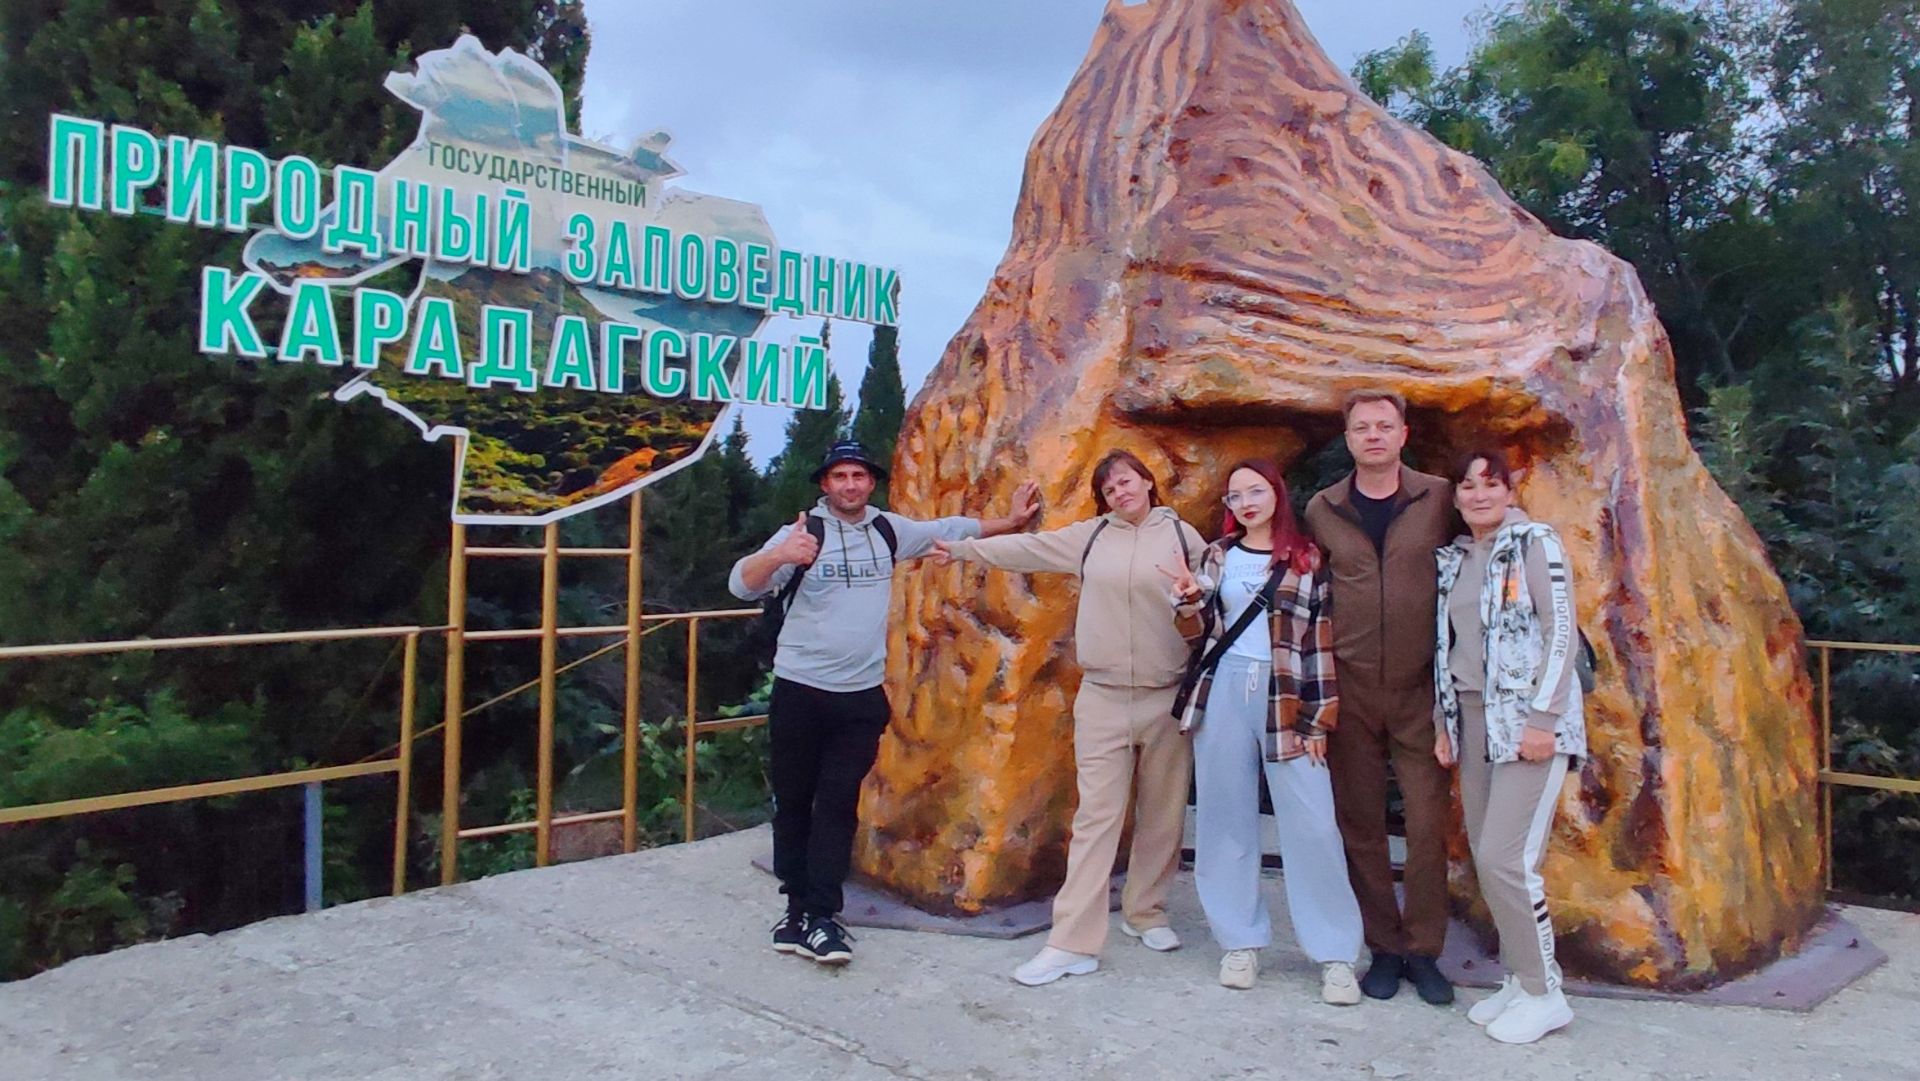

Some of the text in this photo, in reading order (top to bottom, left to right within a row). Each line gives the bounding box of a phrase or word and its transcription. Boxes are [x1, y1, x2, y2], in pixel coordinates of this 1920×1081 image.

[48, 113, 900, 327] ПРИРОДНЫЙ ЗАПОВЕДНИК
[428, 141, 647, 209] ГОСУДАРСТВЕННЫЙ
[200, 265, 828, 411] КАРАДАГСКИЙ
